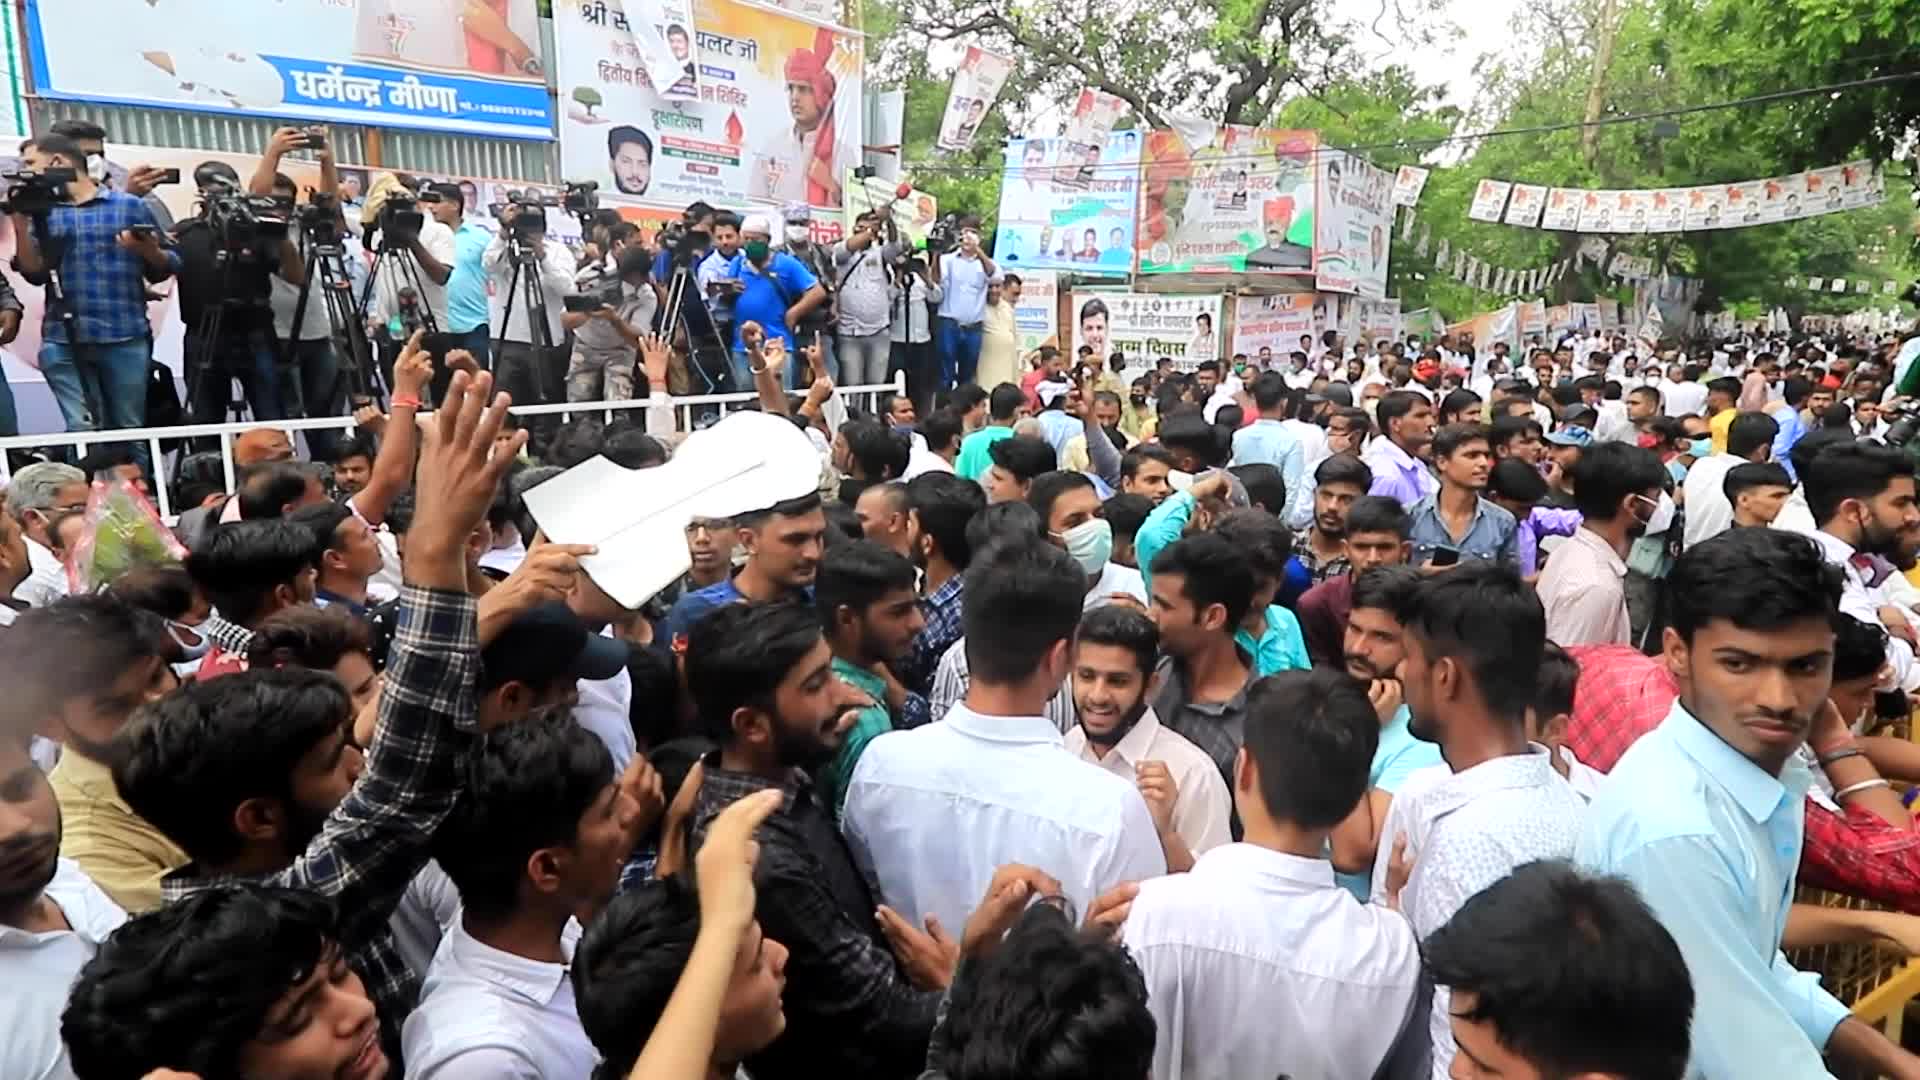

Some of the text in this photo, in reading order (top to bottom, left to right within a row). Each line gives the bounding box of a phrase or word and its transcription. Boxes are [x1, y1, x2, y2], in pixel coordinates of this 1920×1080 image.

[582, 1, 607, 27] श्री
[695, 31, 758, 62] यलट जी
[289, 64, 382, 108] धर्मेन्द्र
[384, 76, 458, 114] मीणा
[1111, 337, 1186, 357] जन्म दिवस
